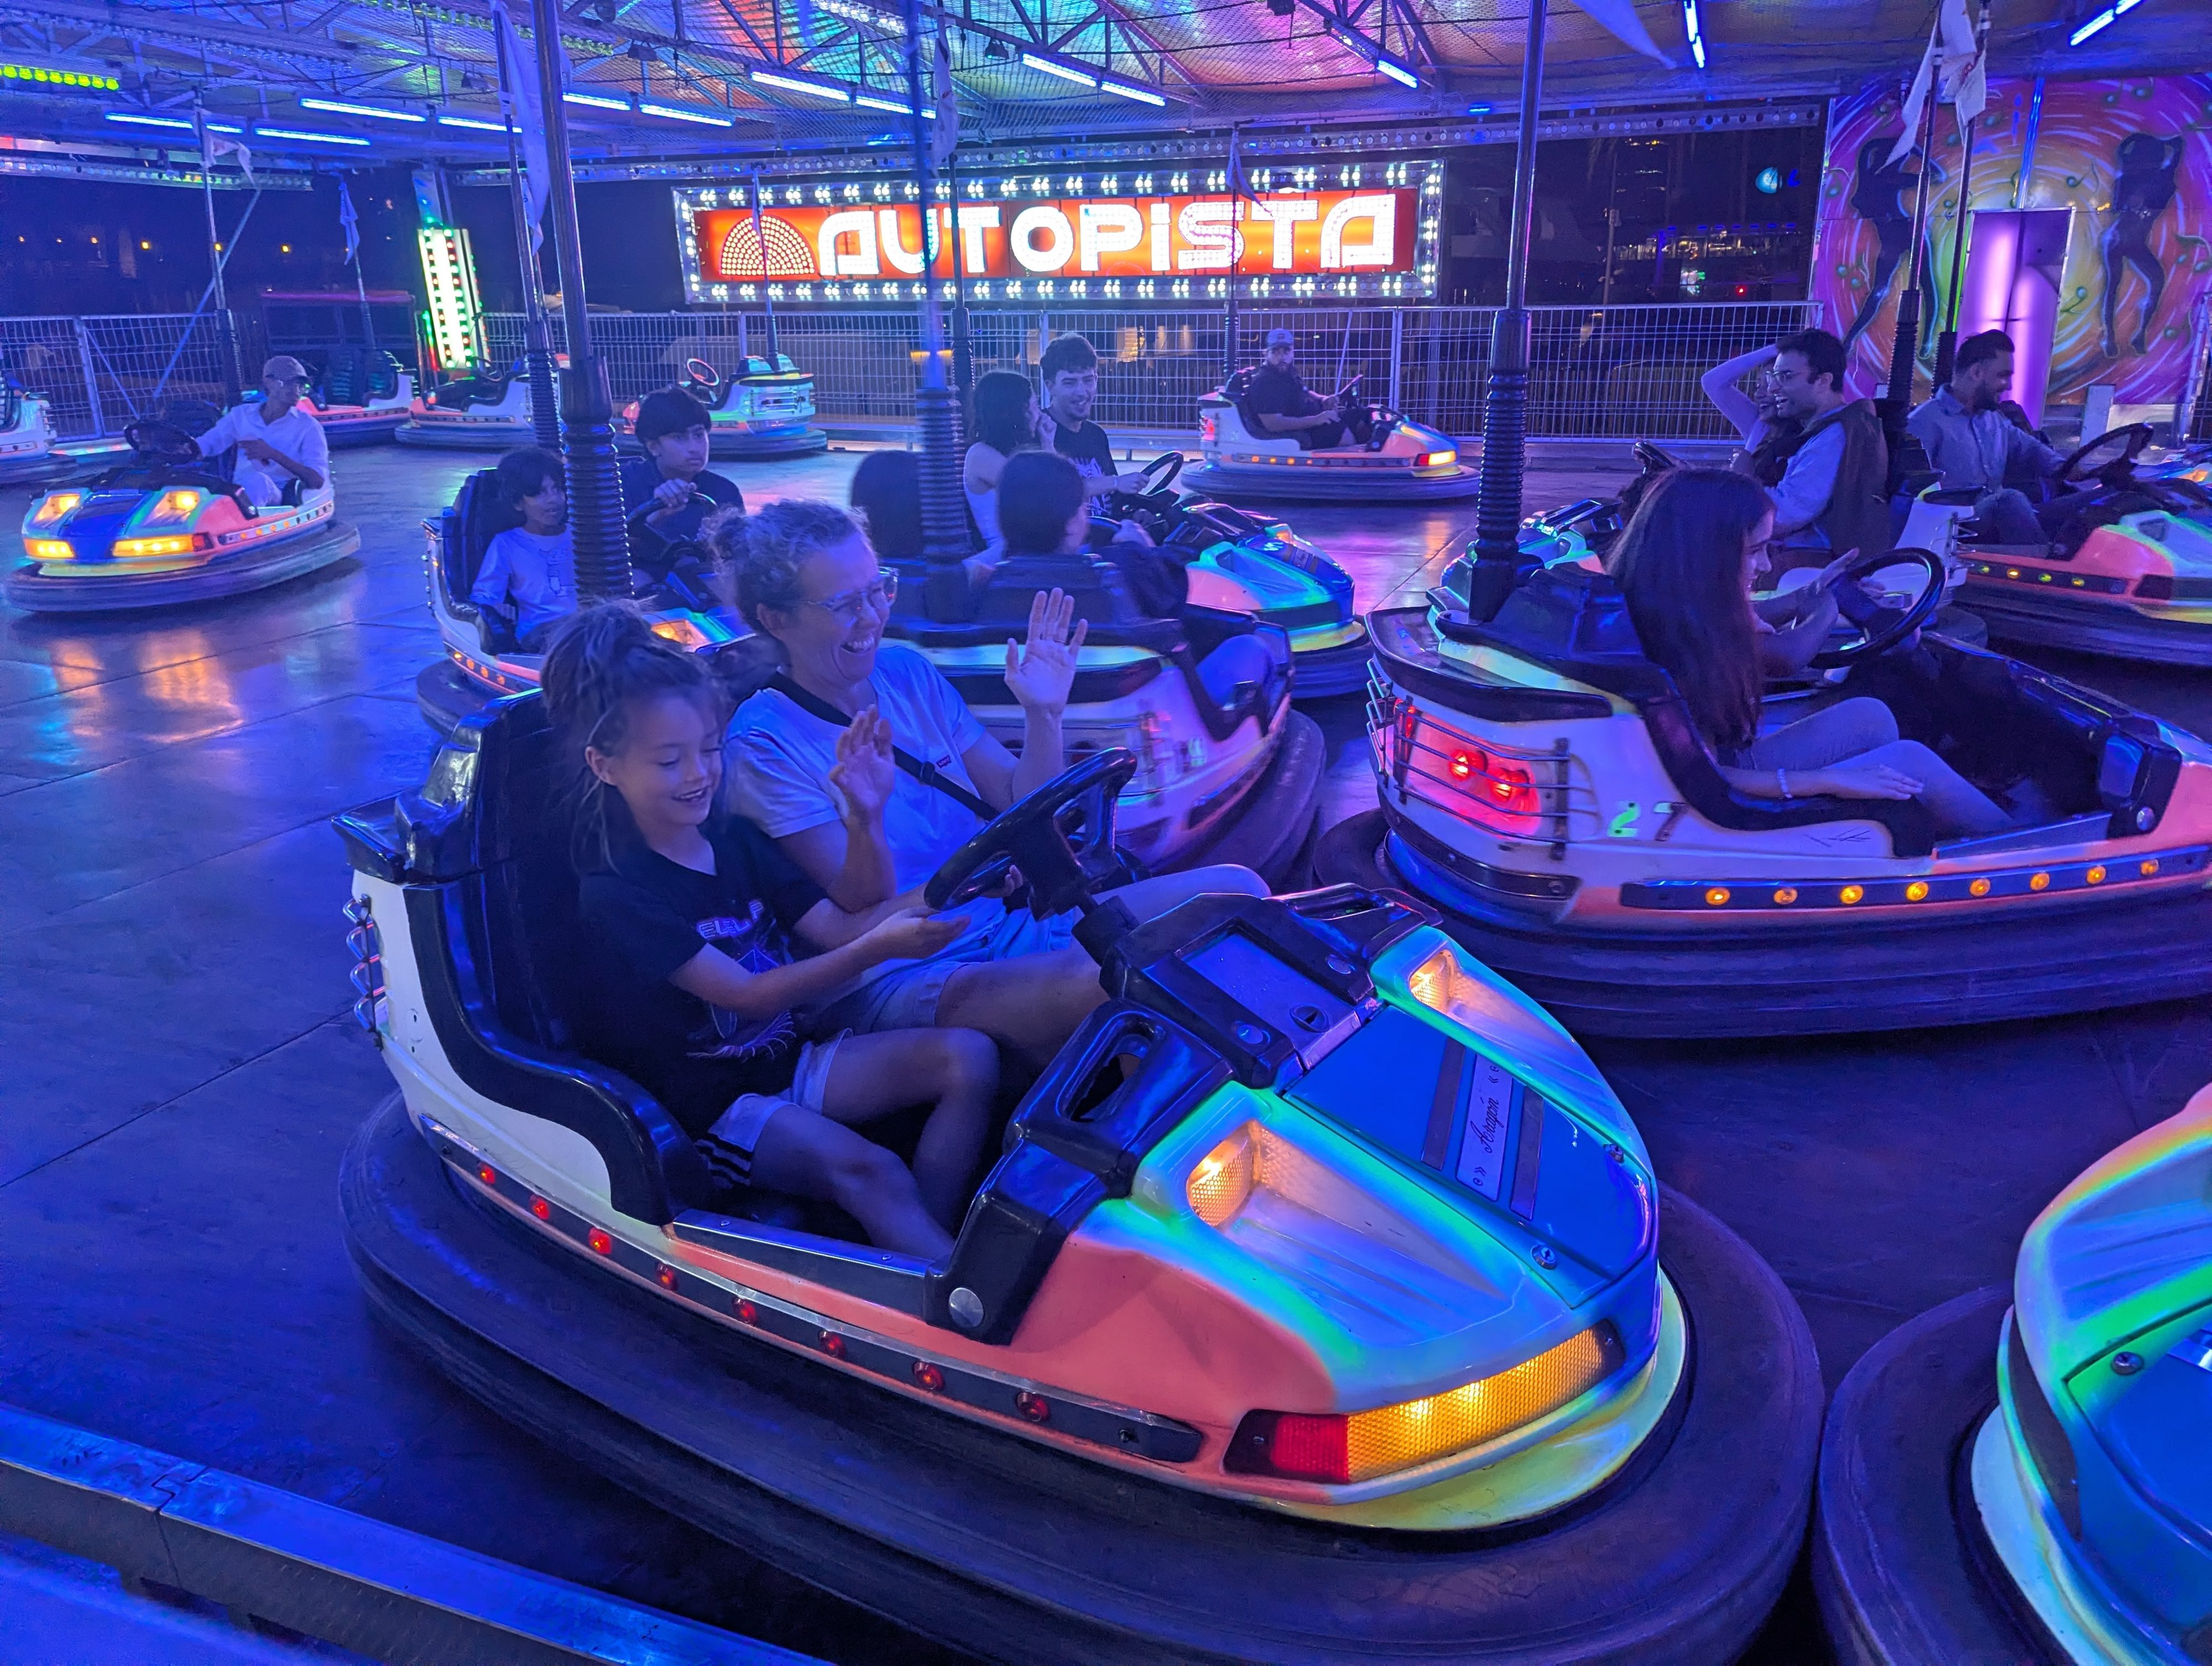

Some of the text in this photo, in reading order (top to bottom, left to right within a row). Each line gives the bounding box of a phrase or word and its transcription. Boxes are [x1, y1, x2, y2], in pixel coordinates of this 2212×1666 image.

[818, 194, 1396, 276] AUTOPISTA
[1607, 800, 1688, 841] 27
[1470, 1097, 1504, 1154] Aragón
